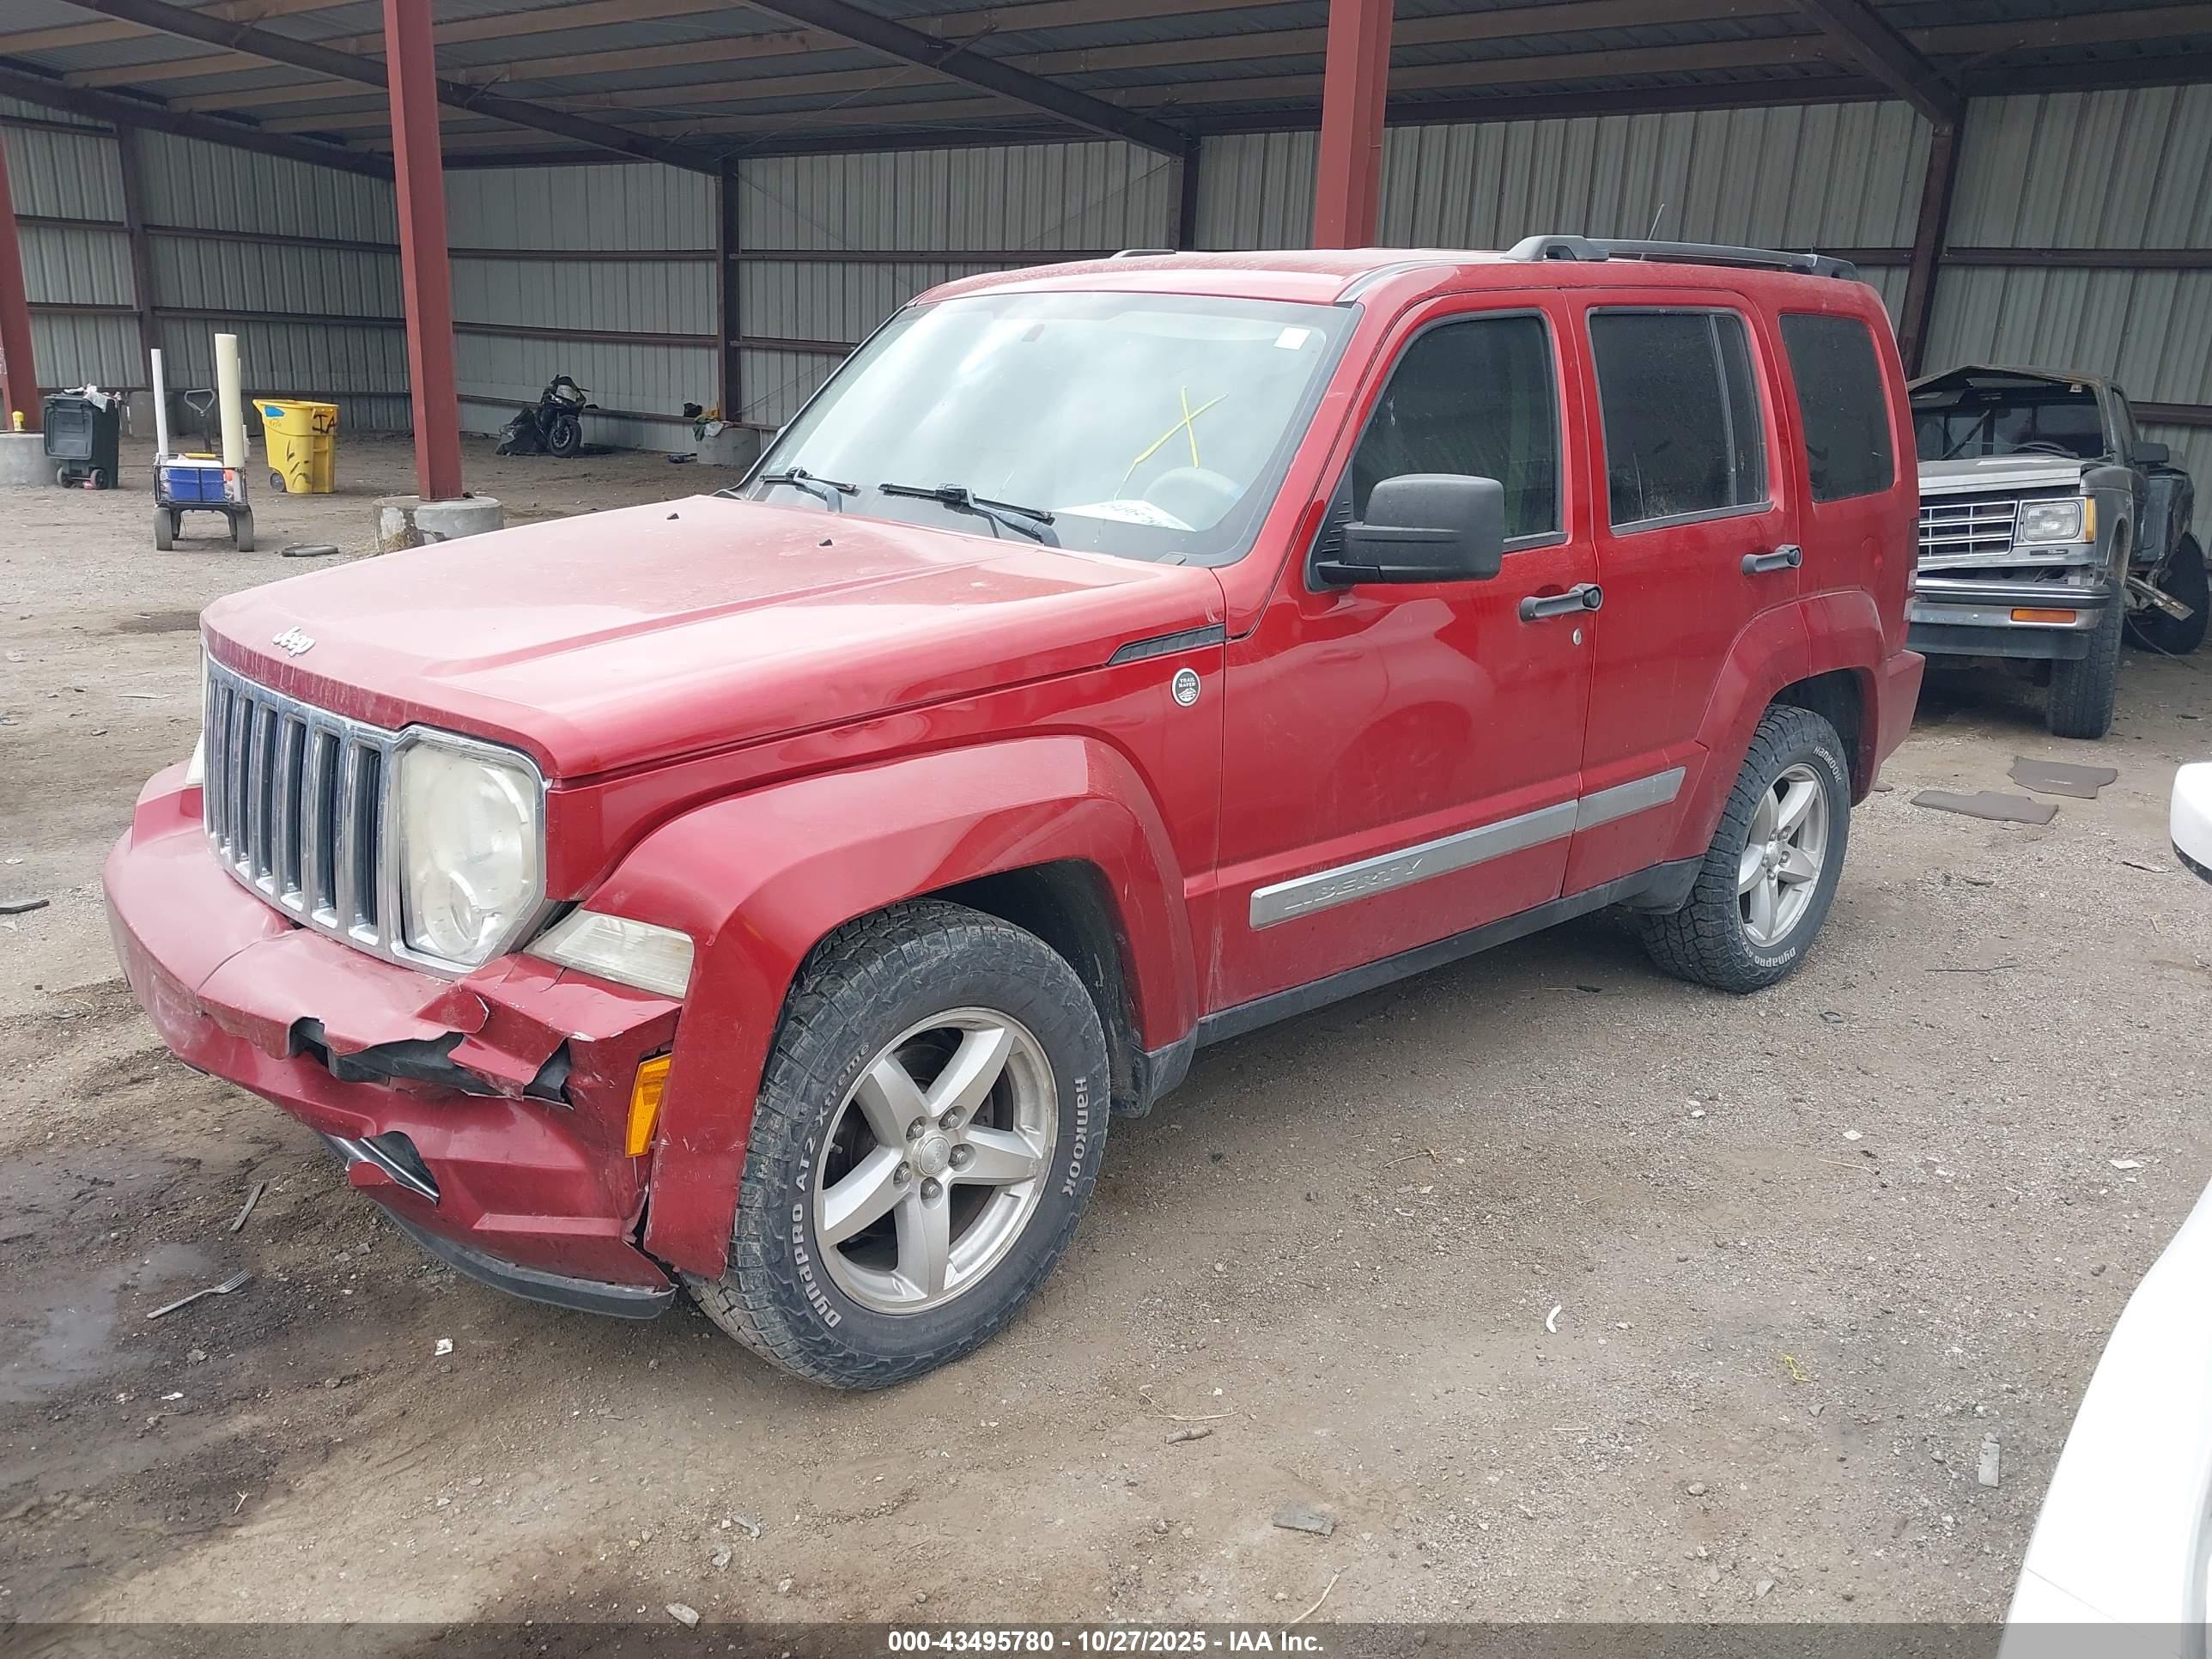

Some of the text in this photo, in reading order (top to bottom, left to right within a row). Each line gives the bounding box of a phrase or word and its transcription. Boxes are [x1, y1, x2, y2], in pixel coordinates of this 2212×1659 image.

[271, 625, 317, 659] Jeep
[1284, 859, 1424, 912] LIBERTY
[795, 1136, 816, 1192] AT2
[813, 1042, 871, 1128] Xtreme
